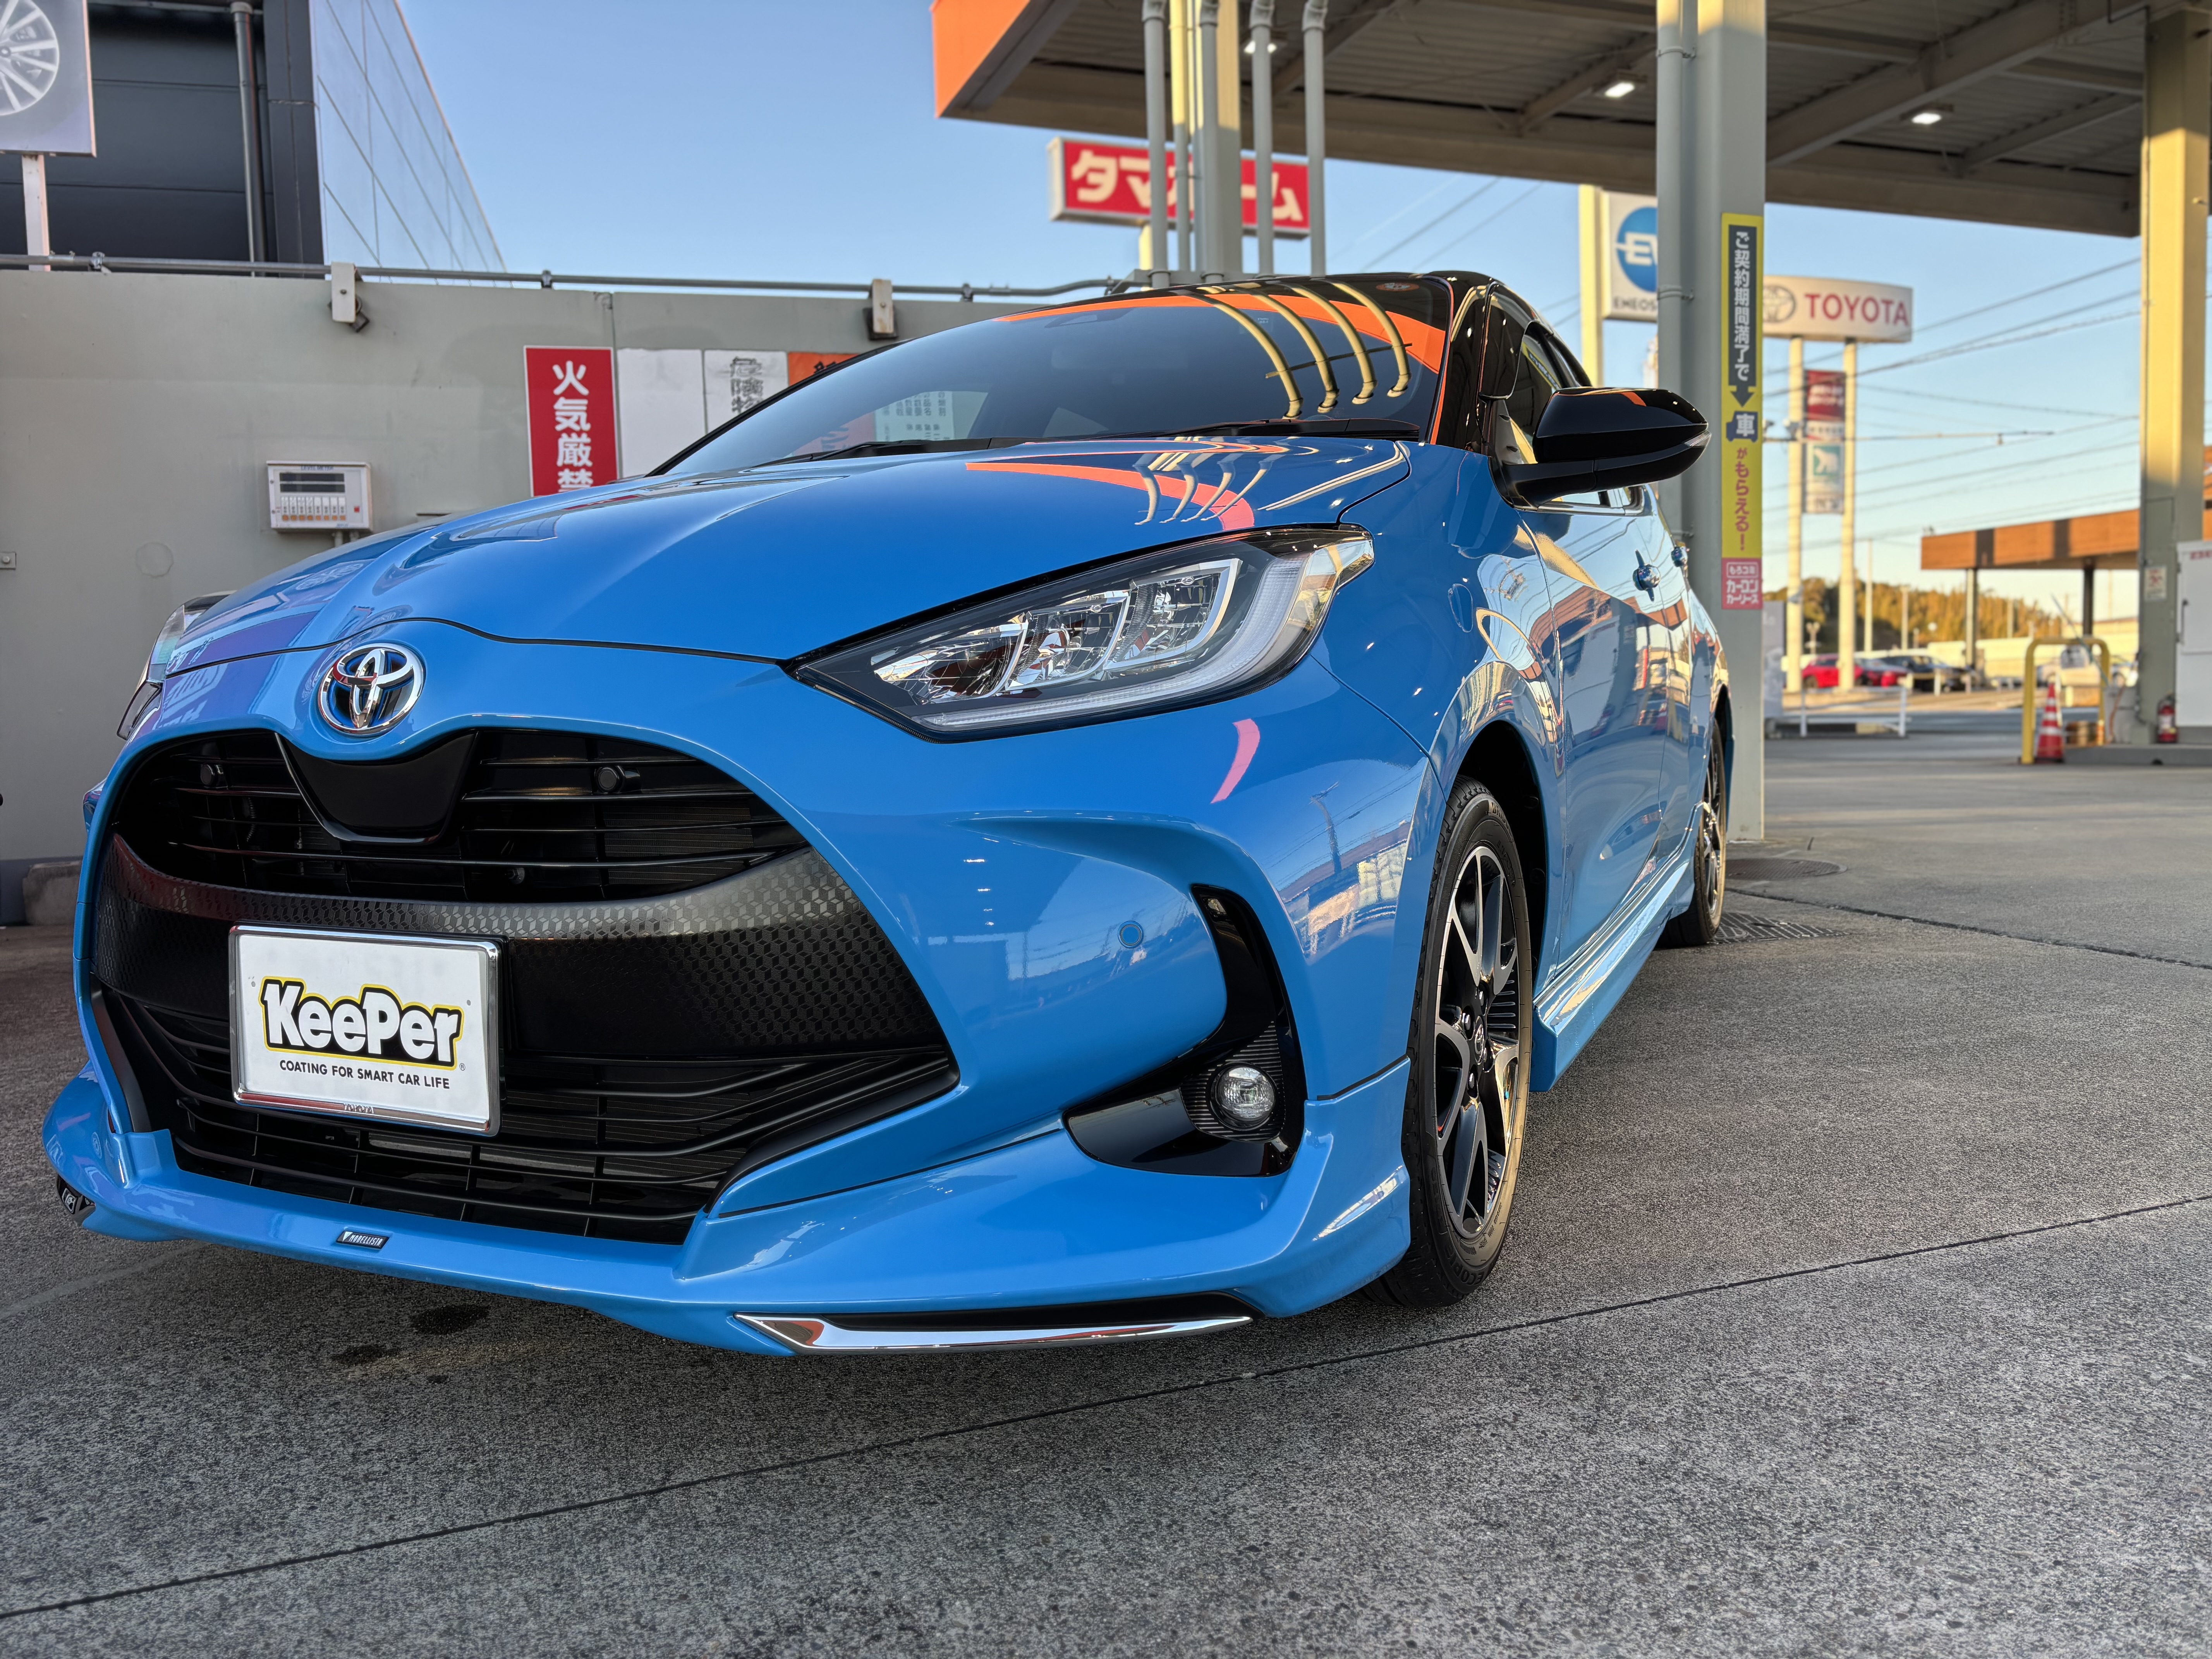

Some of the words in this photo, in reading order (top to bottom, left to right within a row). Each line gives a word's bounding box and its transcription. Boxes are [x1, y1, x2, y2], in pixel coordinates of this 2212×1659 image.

[1734, 231, 1750, 381] ご契約期間満了で
[1804, 293, 1909, 326] TOYOTA
[552, 360, 594, 492] 火気厳禁
[1736, 414, 1755, 436] 車
[1726, 594, 1759, 605] カーリース
[261, 979, 462, 1067] KeePer
[280, 1060, 327, 1075] COATING
[332, 1065, 354, 1078] FOR
[357, 1068, 394, 1083] SMART
[398, 1072, 420, 1086] CAR
[424, 1075, 450, 1089] LIFE
[349, 1234, 383, 1246] MODELLISTA
